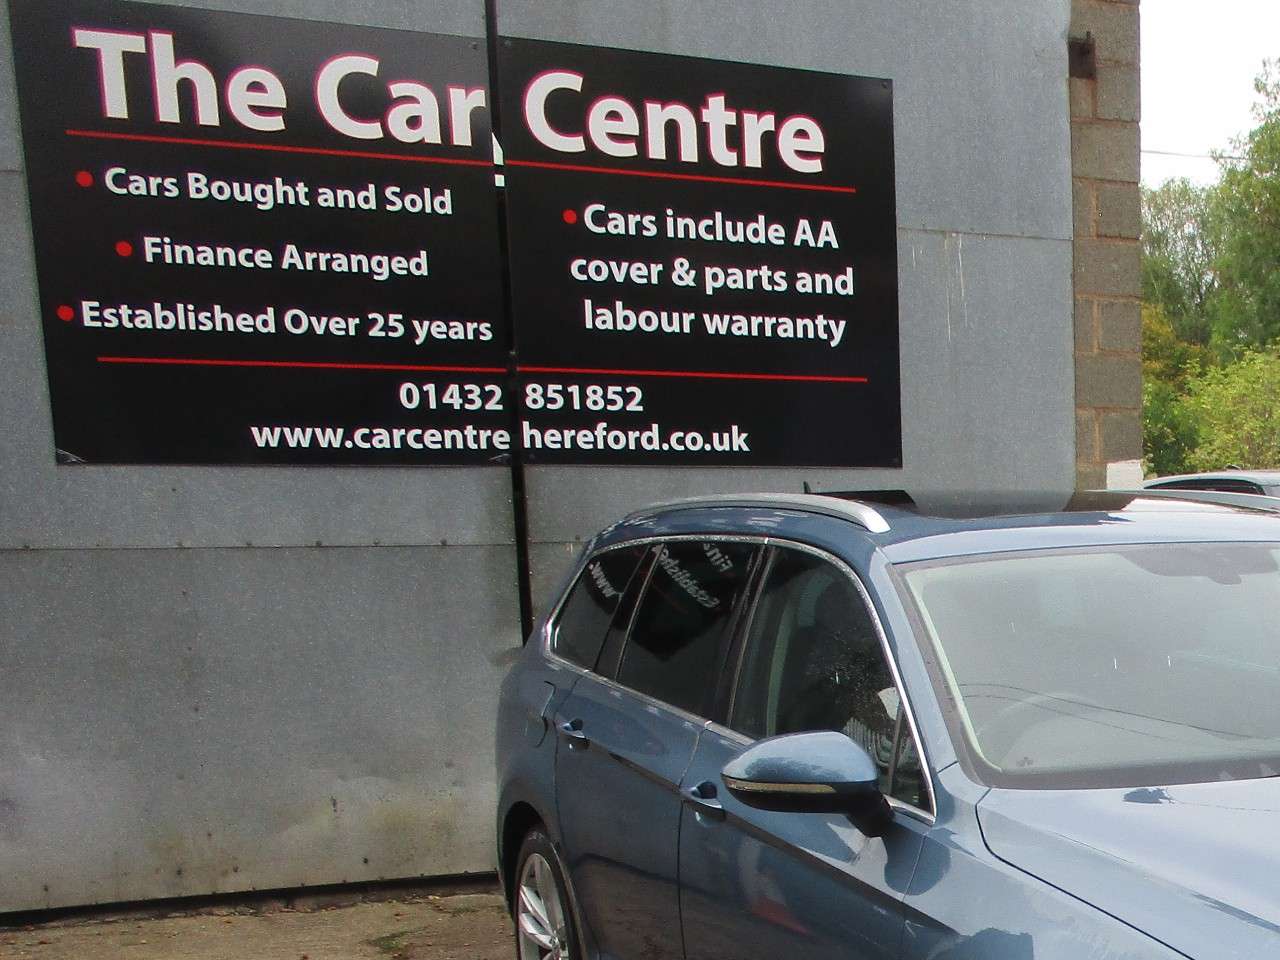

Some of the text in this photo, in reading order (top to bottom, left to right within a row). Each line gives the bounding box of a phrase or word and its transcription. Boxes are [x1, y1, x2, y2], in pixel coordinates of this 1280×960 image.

[73, 28, 827, 173] The Car Centre
[104, 167, 453, 215] Cars Bought and Sold
[583, 203, 840, 249] Cars include AA
[143, 236, 429, 280] Finance Arranged
[570, 257, 854, 296] cover & parts and
[81, 300, 493, 346] Established Over 25 years
[584, 299, 847, 348] labour warranty
[399, 382, 644, 412] 01432 851852
